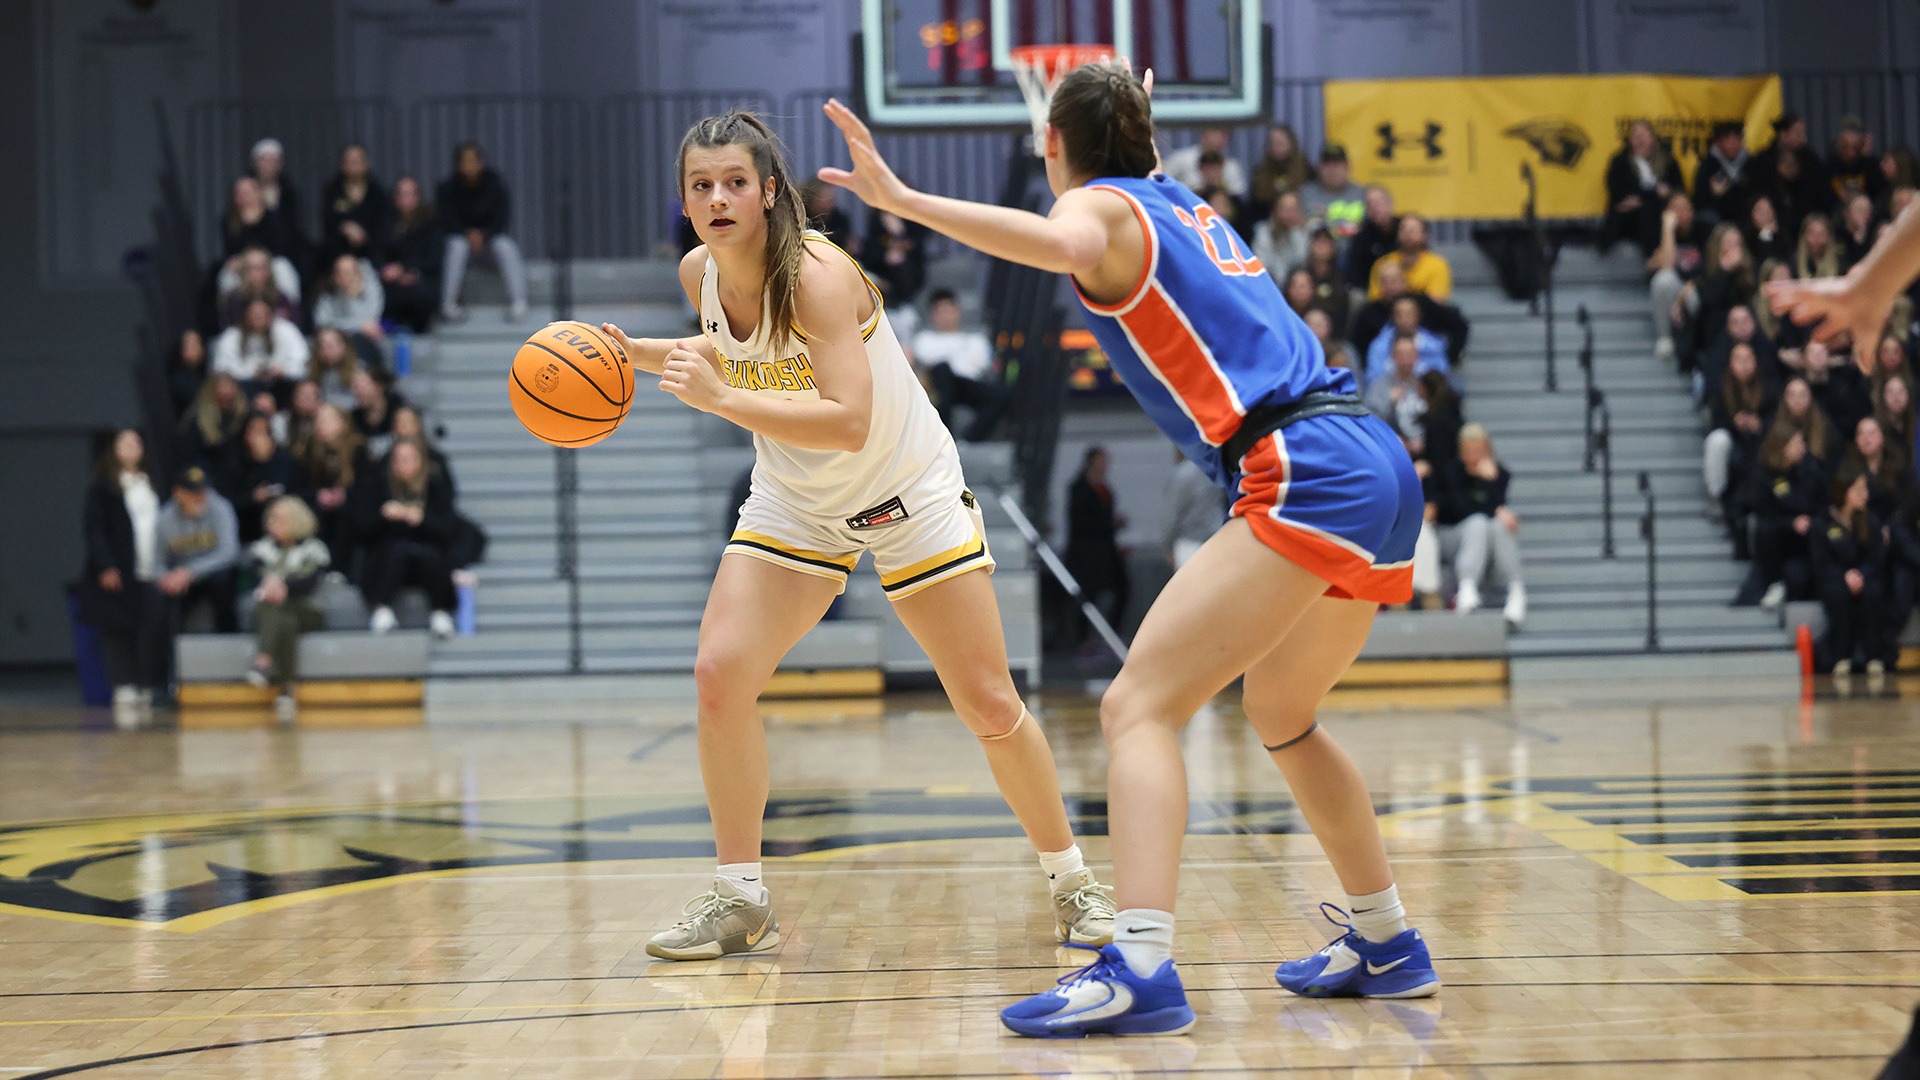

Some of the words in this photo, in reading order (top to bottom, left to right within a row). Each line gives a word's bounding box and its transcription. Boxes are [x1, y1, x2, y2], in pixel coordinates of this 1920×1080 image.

[1171, 203, 1266, 277] 22
[552, 329, 602, 360] EVO
[599, 357, 613, 371] NXT
[714, 347, 818, 391] SHKOSH
